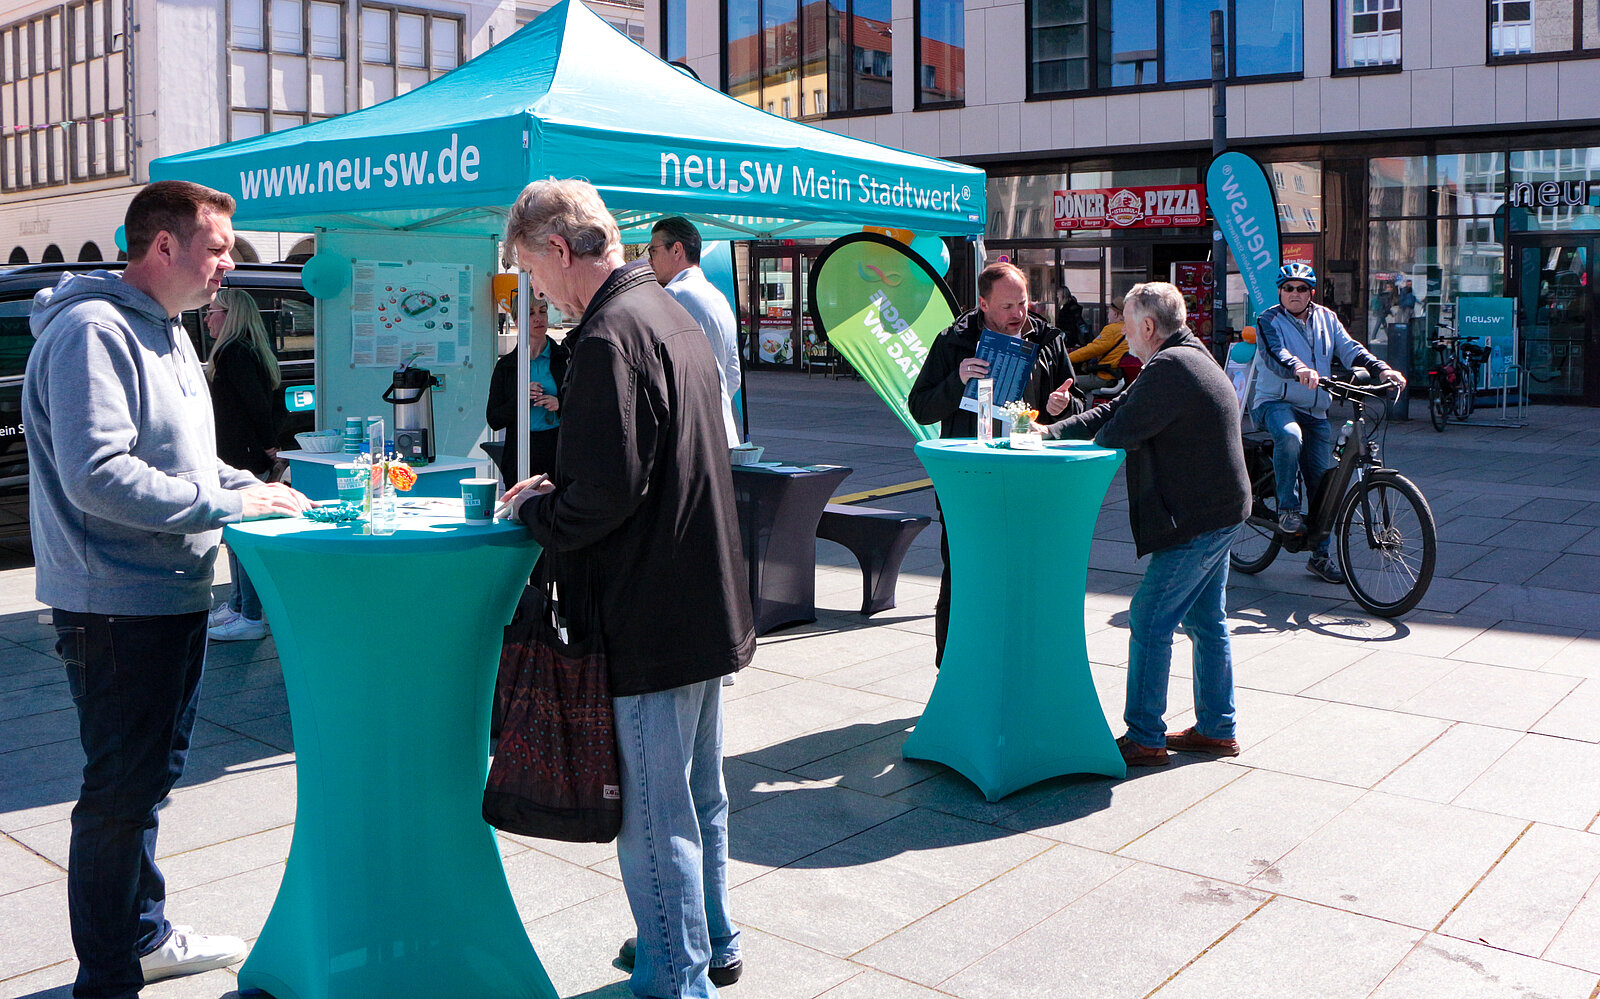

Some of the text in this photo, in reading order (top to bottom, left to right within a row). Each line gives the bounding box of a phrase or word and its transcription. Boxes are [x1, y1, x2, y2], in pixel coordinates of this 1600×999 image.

[240, 133, 480, 200] www.neu-sw.de
[660, 152, 783, 195] neu.sw
[792, 165, 851, 201] Mein
[1054, 191, 1106, 218] DÖNER
[1144, 189, 1200, 216] PIZZA
[0, 423, 25, 437] ein S
